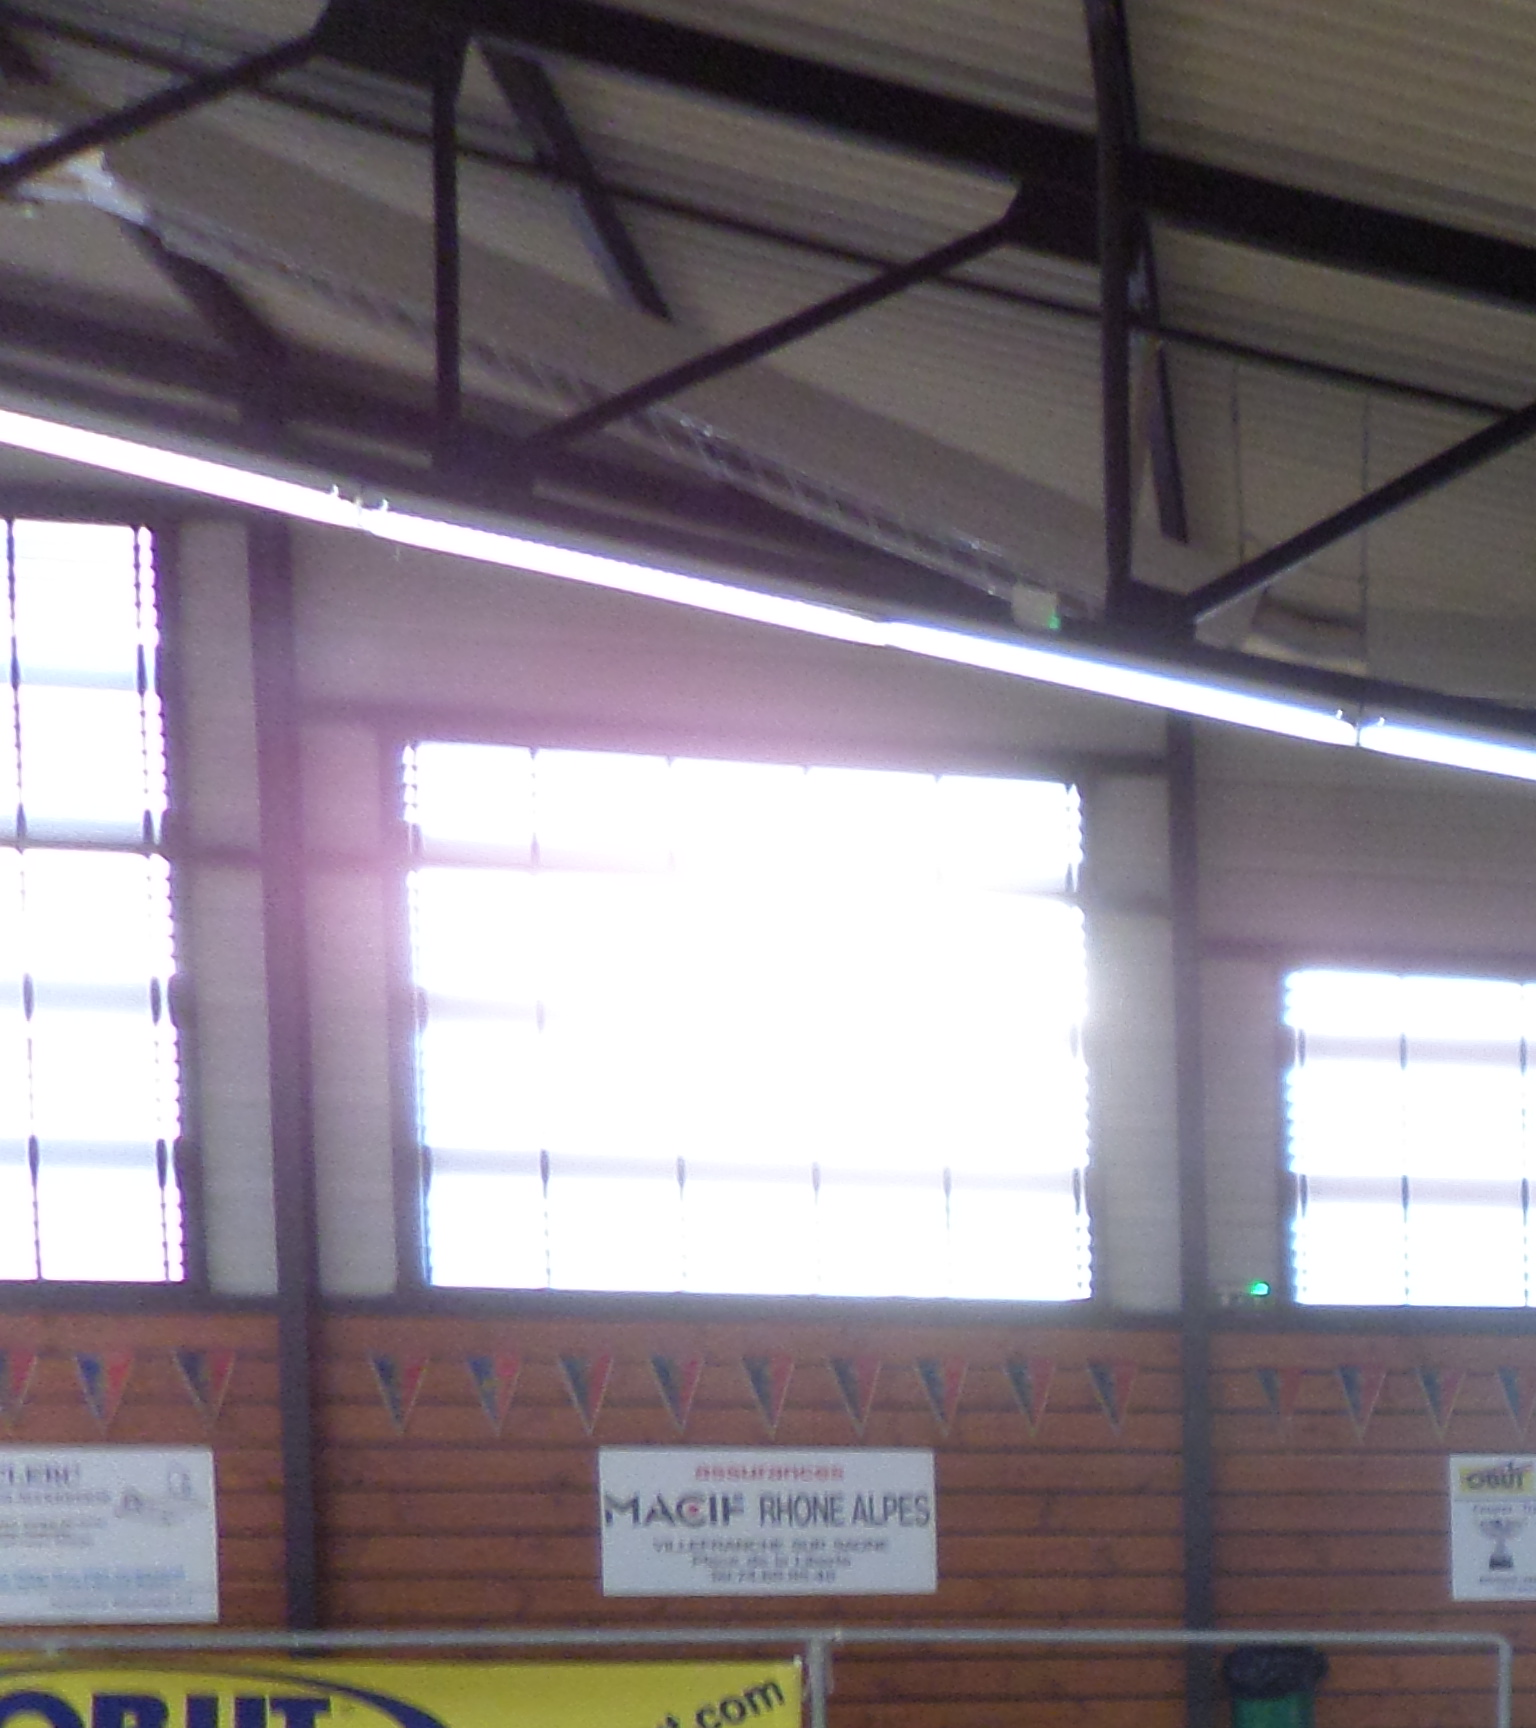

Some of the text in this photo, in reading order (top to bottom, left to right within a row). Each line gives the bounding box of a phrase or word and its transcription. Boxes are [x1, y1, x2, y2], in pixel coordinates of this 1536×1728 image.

[603, 1490, 931, 1528] MACIF RHONE ALPES
